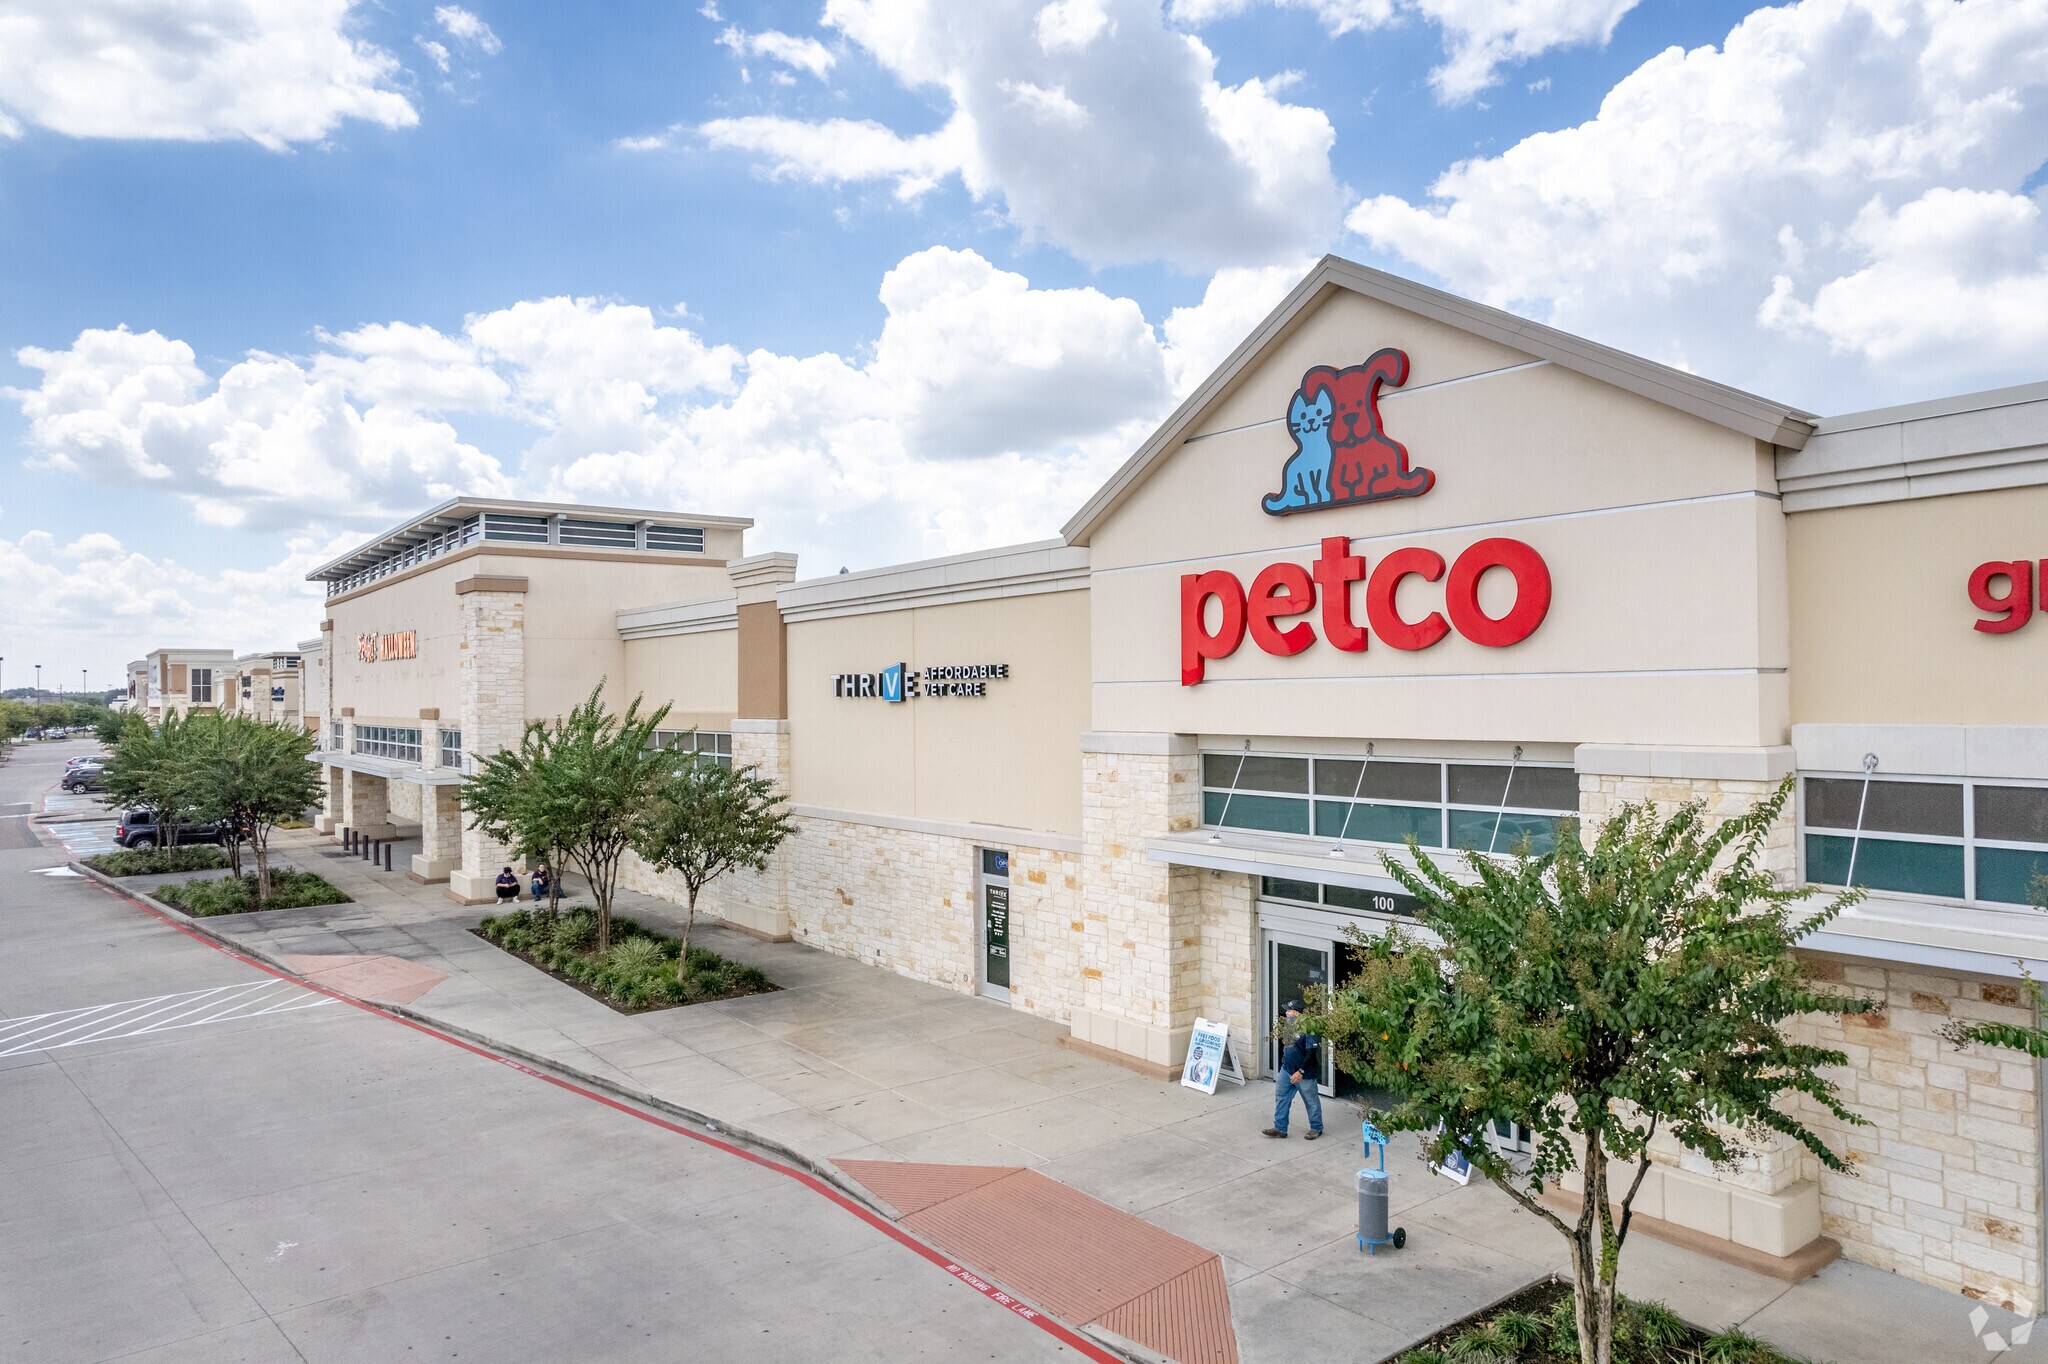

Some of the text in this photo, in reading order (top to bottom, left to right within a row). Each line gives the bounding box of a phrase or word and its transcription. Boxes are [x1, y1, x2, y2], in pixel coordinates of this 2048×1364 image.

[1181, 536, 1552, 686] petco
[1967, 559, 2048, 634] g
[830, 664, 1007, 700] THRIVE AFFORDABLE
[923, 683, 985, 697] VET CARE
[1372, 895, 1395, 912] 100
[945, 1264, 1039, 1319] NO PARKING FIRE LANE
